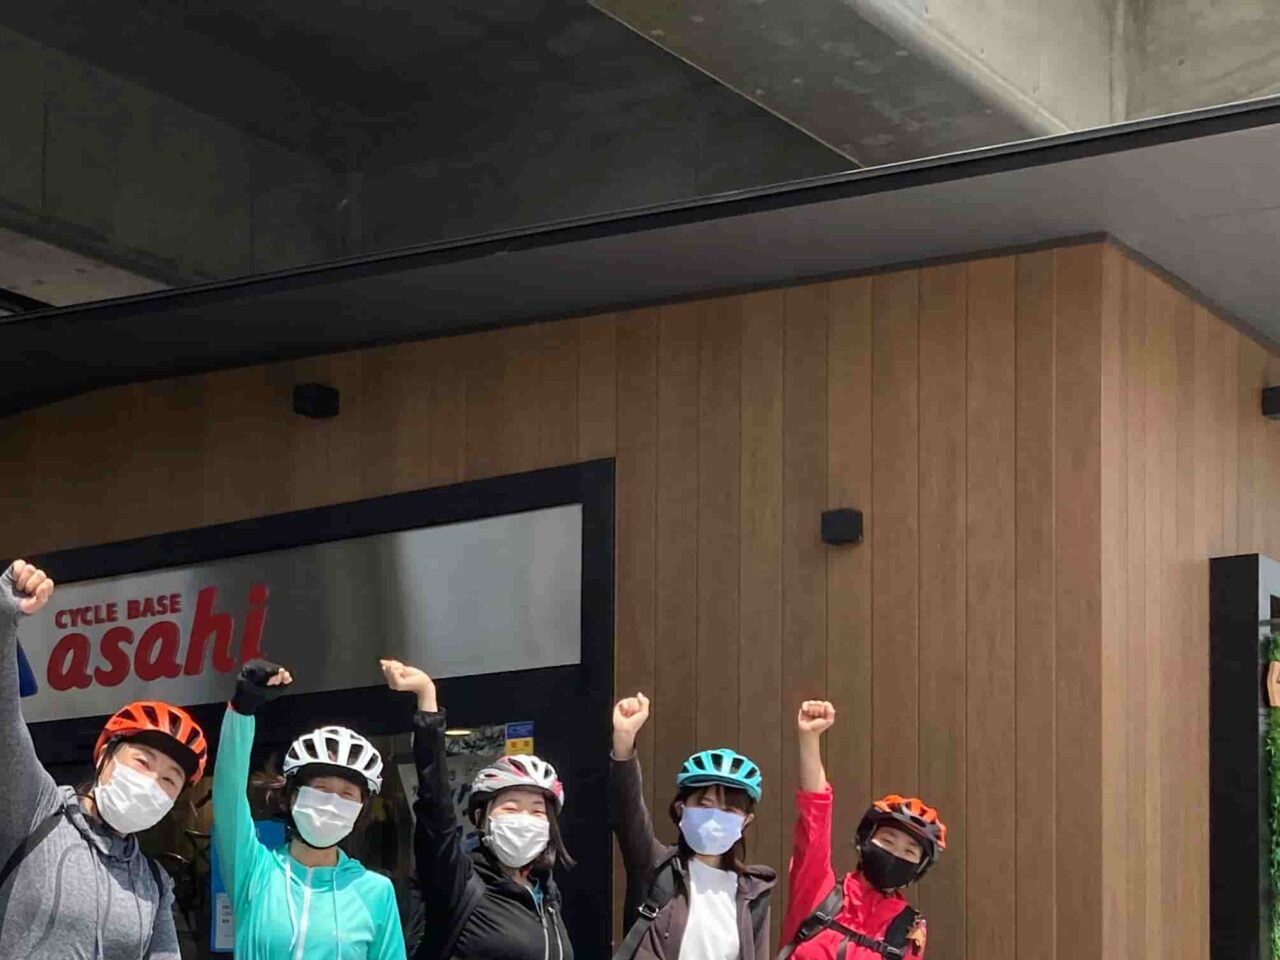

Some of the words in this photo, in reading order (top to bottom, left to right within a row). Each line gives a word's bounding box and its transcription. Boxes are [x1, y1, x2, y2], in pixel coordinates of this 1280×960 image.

[46, 584, 269, 692] asahi
[55, 602, 118, 629] CYCLE
[127, 593, 182, 620] BASE
